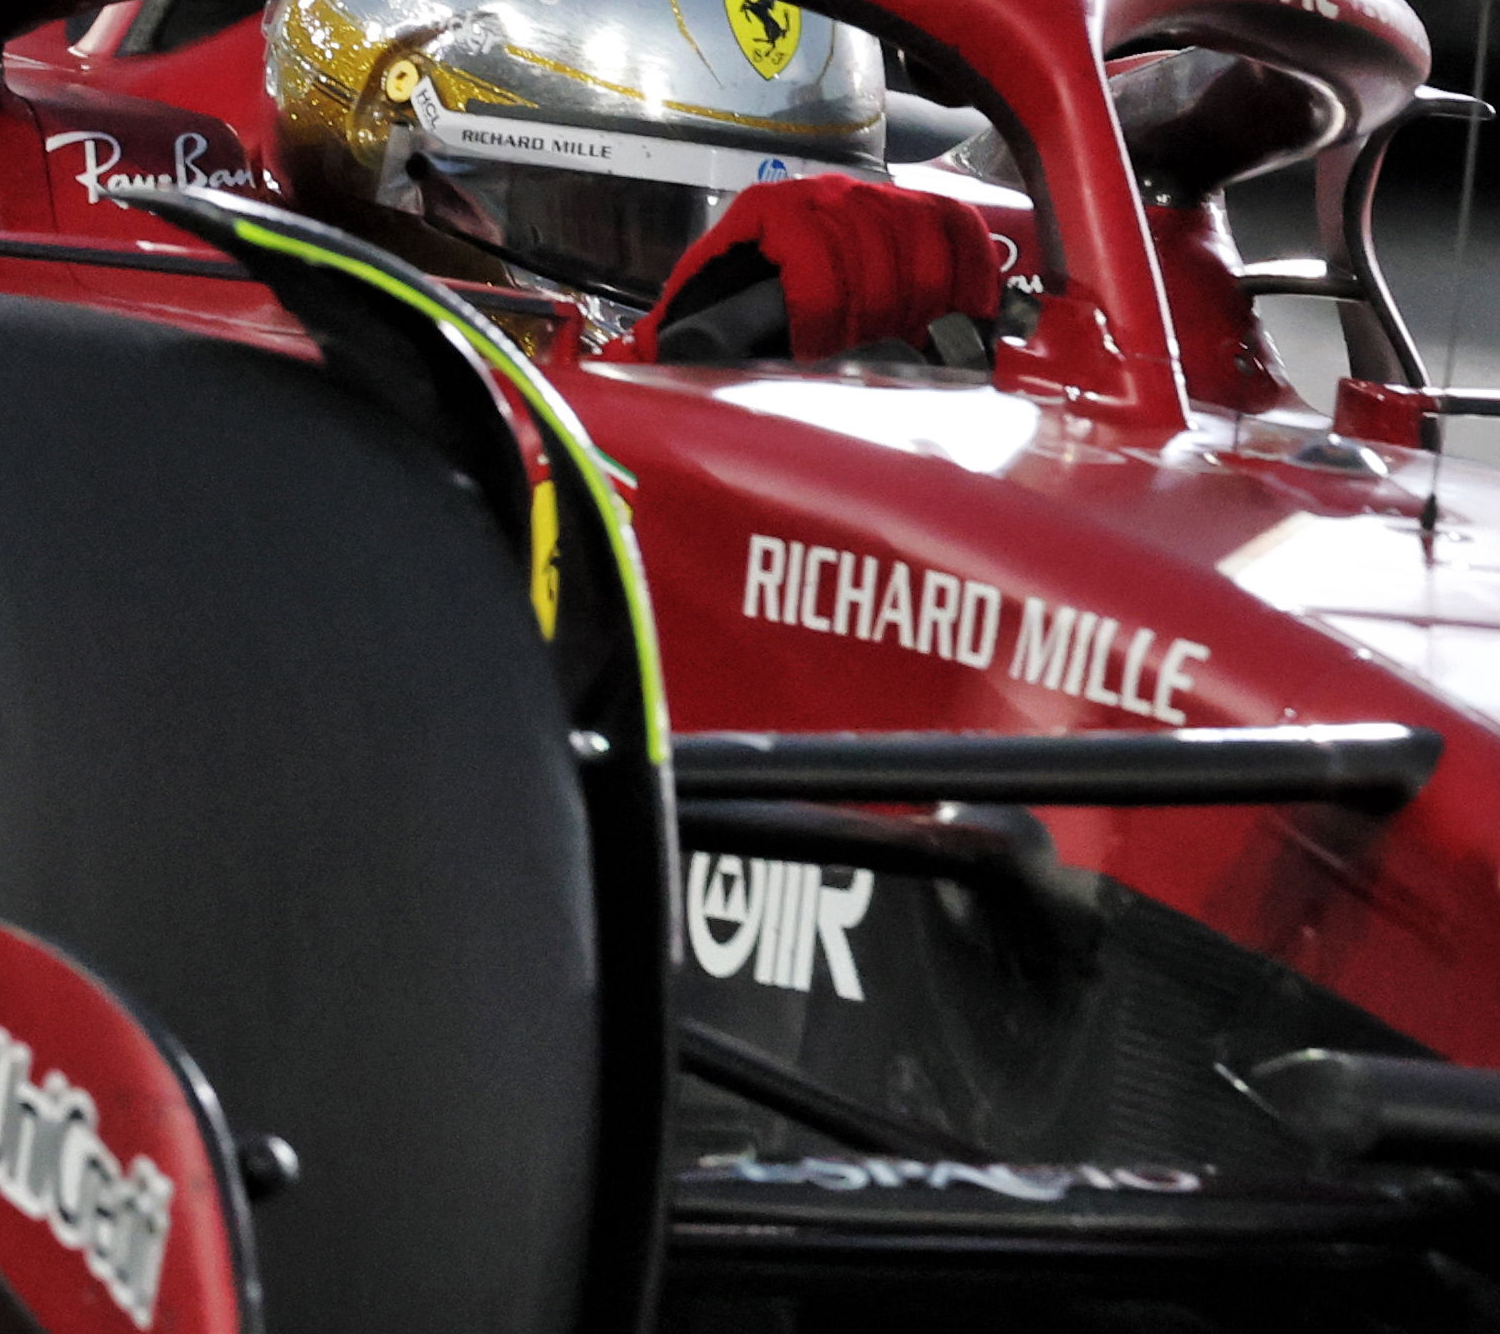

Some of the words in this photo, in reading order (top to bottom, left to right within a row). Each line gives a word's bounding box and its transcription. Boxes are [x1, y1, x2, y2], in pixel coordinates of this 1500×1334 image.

[461, 128, 546, 152] RICHARD
[551, 140, 613, 160] MILLE
[742, 533, 1002, 670] RICHARD
[1009, 596, 1211, 726] MILLE
